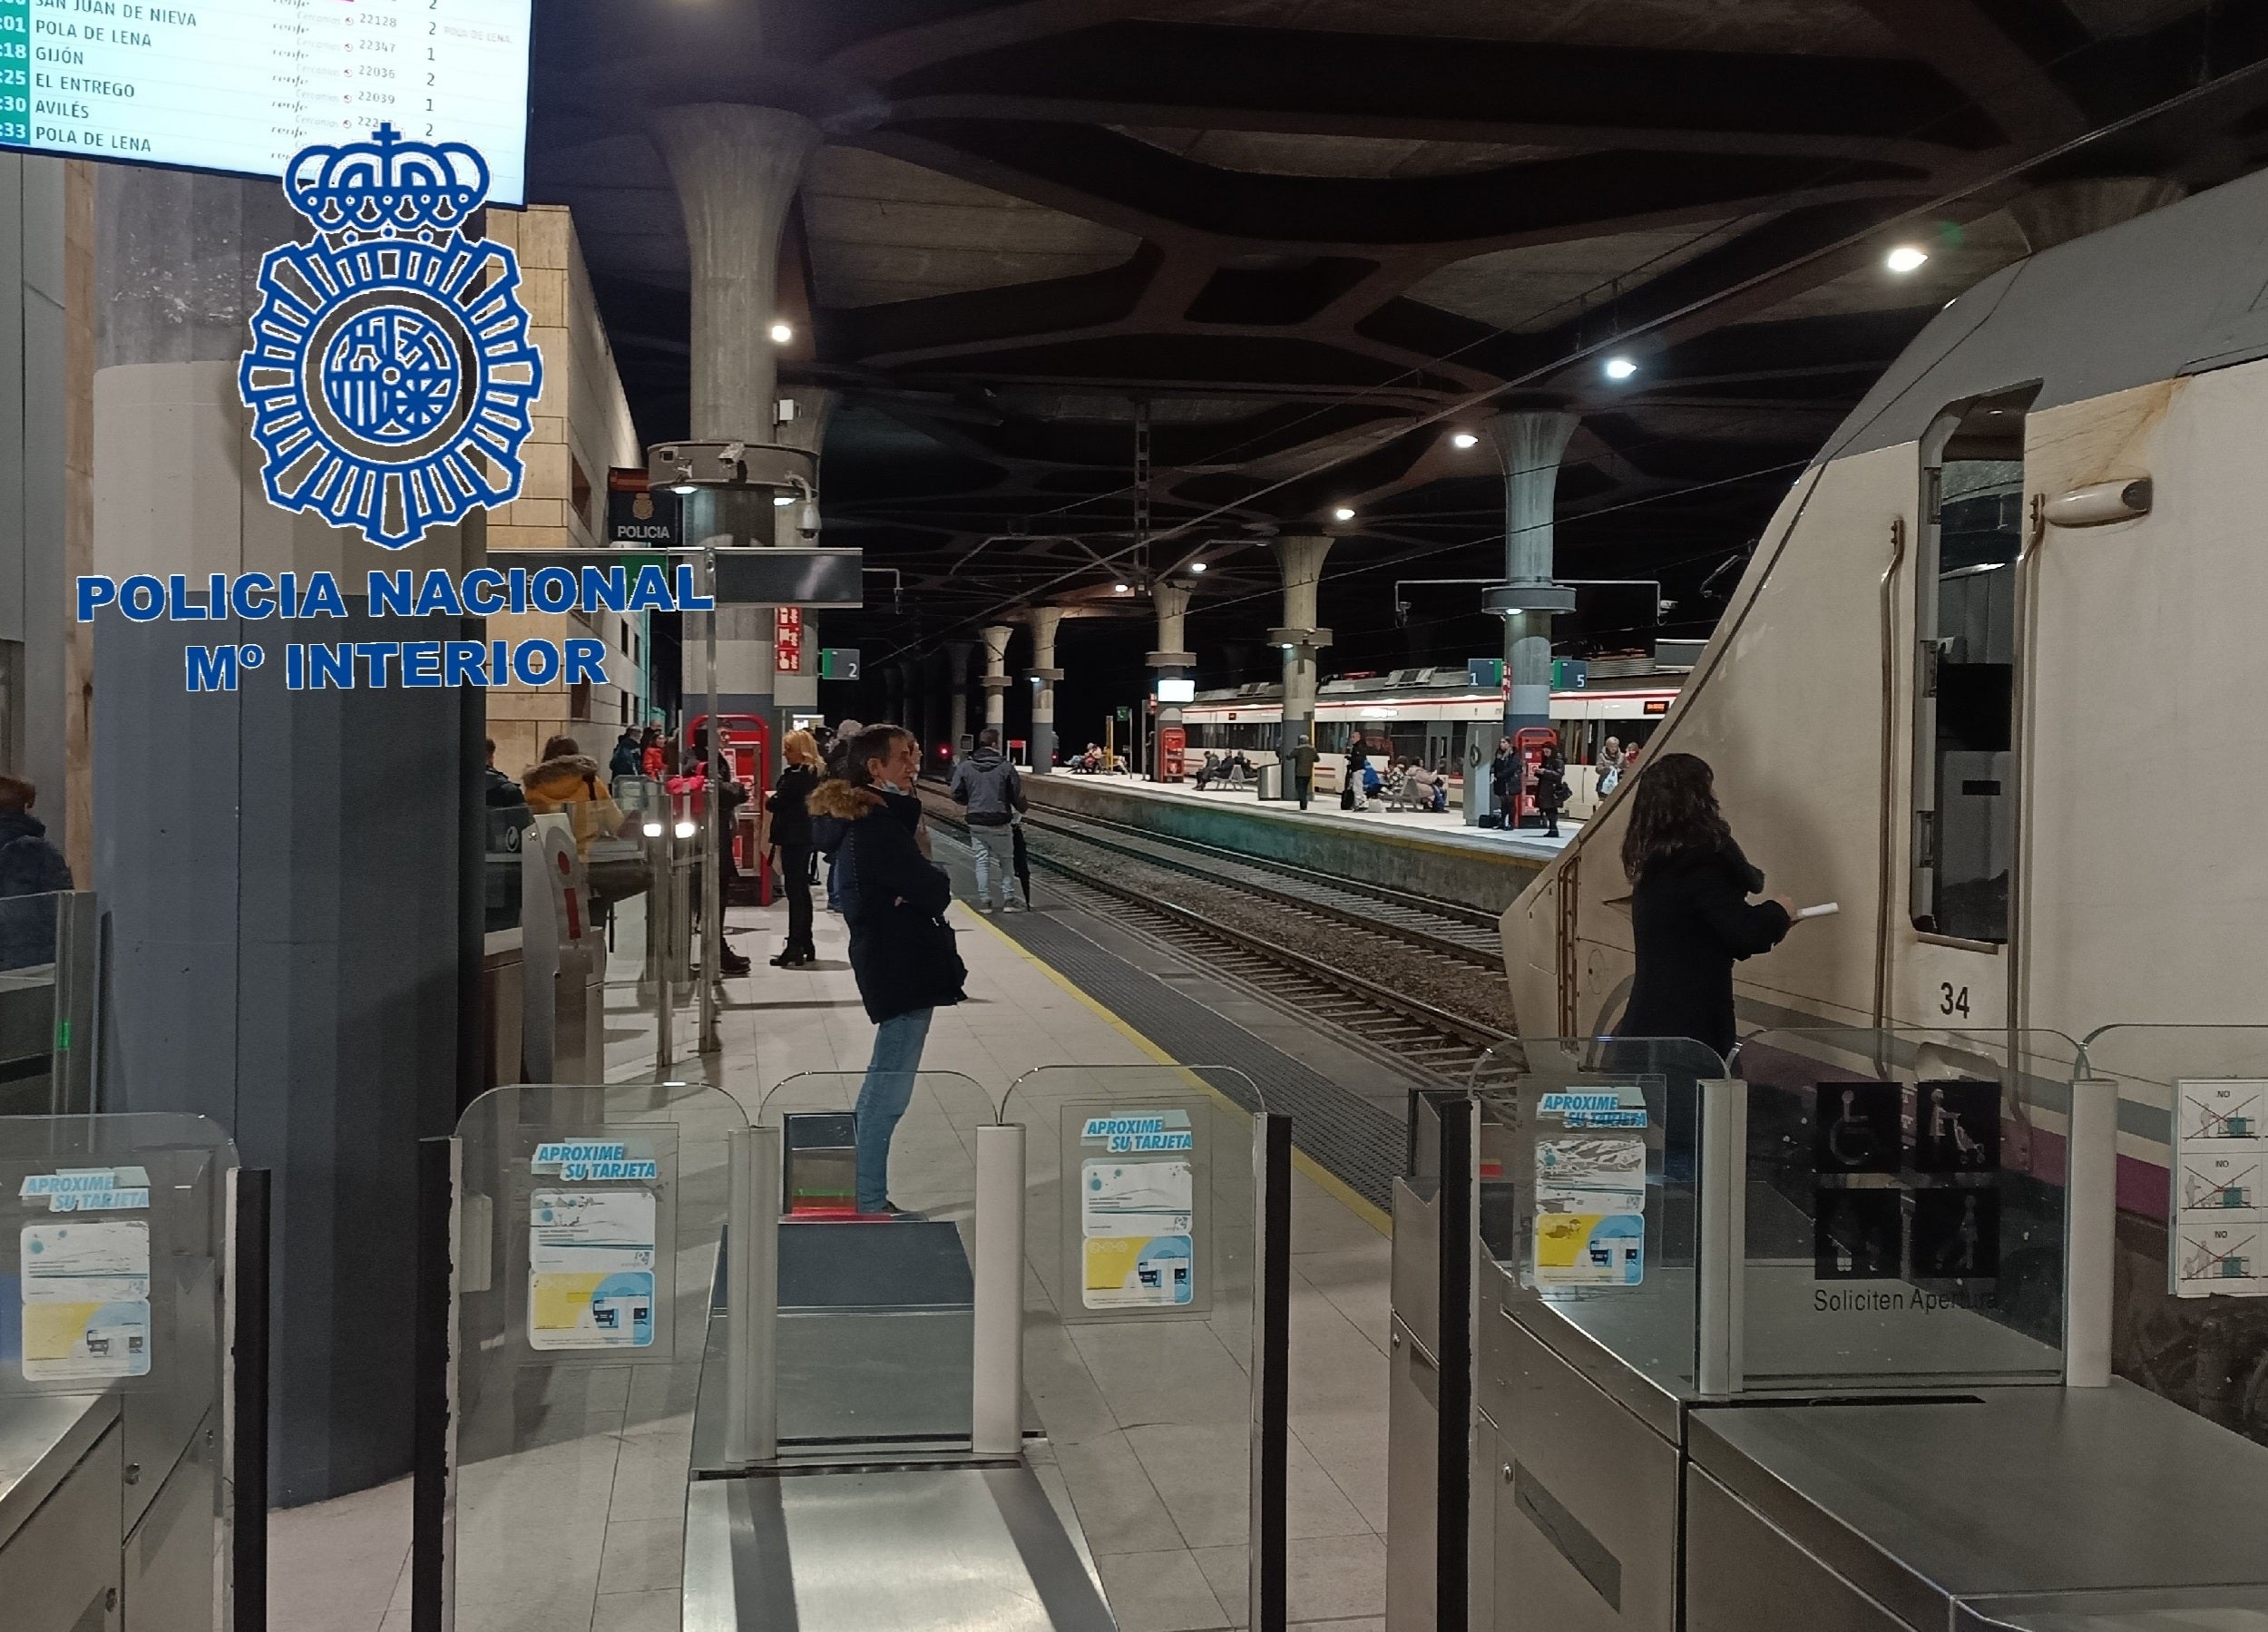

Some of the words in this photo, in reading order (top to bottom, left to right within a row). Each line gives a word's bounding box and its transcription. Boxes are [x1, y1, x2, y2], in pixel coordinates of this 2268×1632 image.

[73, 0, 115, 15] JUAN
[123, 5, 142, 19] DE
[151, 8, 197, 26] NIEVA
[359, 13, 397, 28] 22128
[428, 21, 437, 35] 2
[36, 20, 77, 38] POLA
[84, 25, 104, 42] DE
[112, 30, 152, 46] LENA
[36, 46, 83, 65] GIJÓN
[359, 39, 396, 54] 22347
[427, 47, 436, 61] 1
[358, 64, 396, 79] 22036
[426, 73, 435, 86] 2
[36, 73, 53, 88] EL
[61, 76, 135, 97] ENTREGO
[35, 99, 90, 119] AVILÉS
[357, 90, 396, 104] 22039
[425, 99, 435, 112] 1
[425, 123, 434, 137] 2
[36, 126, 77, 143] POLA
[84, 132, 104, 147] DE
[112, 134, 152, 151] LENA
[617, 525, 670, 539] POLICIA
[848, 662, 857, 678] 2
[1470, 672, 1479, 686] 1
[1577, 674, 1585, 688] 5
[1940, 982, 1970, 1019] 34
[1544, 1096, 1618, 1109] APROXIME
[1088, 1119, 1162, 1134] APROXIME
[1112, 1137, 1130, 1150] SU
[1135, 1134, 1191, 1148] TARJETA
[539, 1147, 622, 1160] APROXIME
[566, 1164, 586, 1178] SU
[592, 1163, 655, 1178] TARJETA
[2215, 1159, 2229, 1168] NO
[27, 1178, 113, 1192] APROXIME
[56, 1195, 76, 1209] SU
[83, 1192, 148, 1207] TARJETA
[2214, 1230, 2228, 1238] NO
[1814, 1289, 1903, 1312] Soliciten
